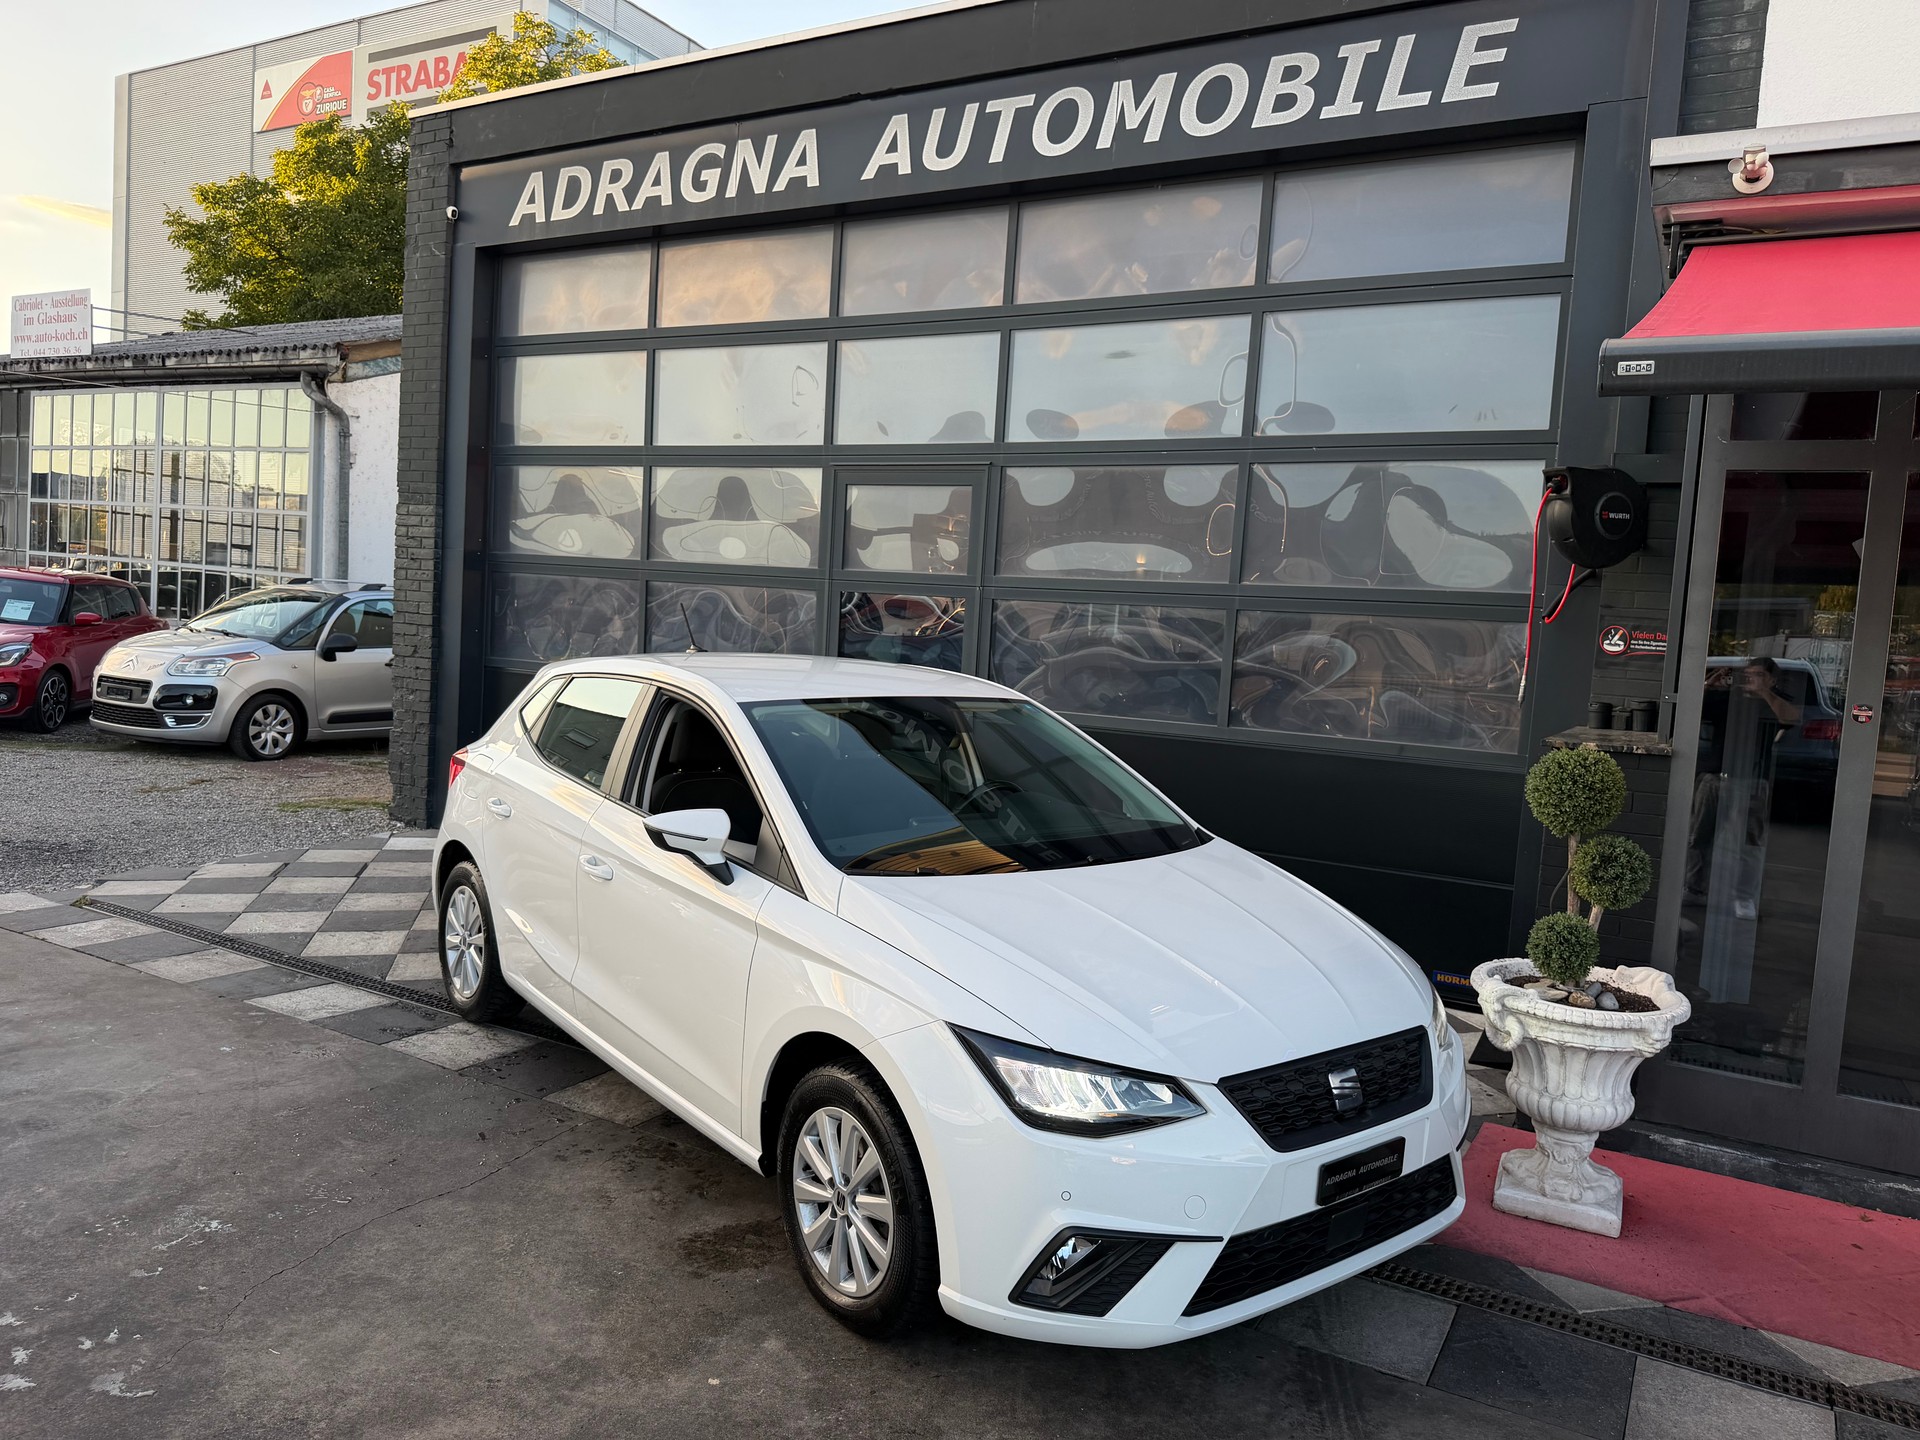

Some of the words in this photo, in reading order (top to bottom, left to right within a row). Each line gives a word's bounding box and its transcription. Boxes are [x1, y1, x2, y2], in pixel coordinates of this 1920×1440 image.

[366, 51, 468, 101] STRABA
[316, 99, 347, 115] ZURIQUE
[508, 128, 820, 227] ADRAGNA
[860, 17, 1519, 181] AUTOMOBILE
[14, 297, 43, 312] Cabriolet
[50, 294, 88, 310] Ausstellung
[23, 314, 34, 326] im
[37, 311, 78, 325] Glashaus
[14, 327, 88, 344] www.auto-koch.ch
[33, 348, 46, 357] 044
[1631, 631, 1655, 640] Vielen
[1656, 632, 1668, 641] Da
[1325, 1169, 1357, 1186] ADRAGNA
